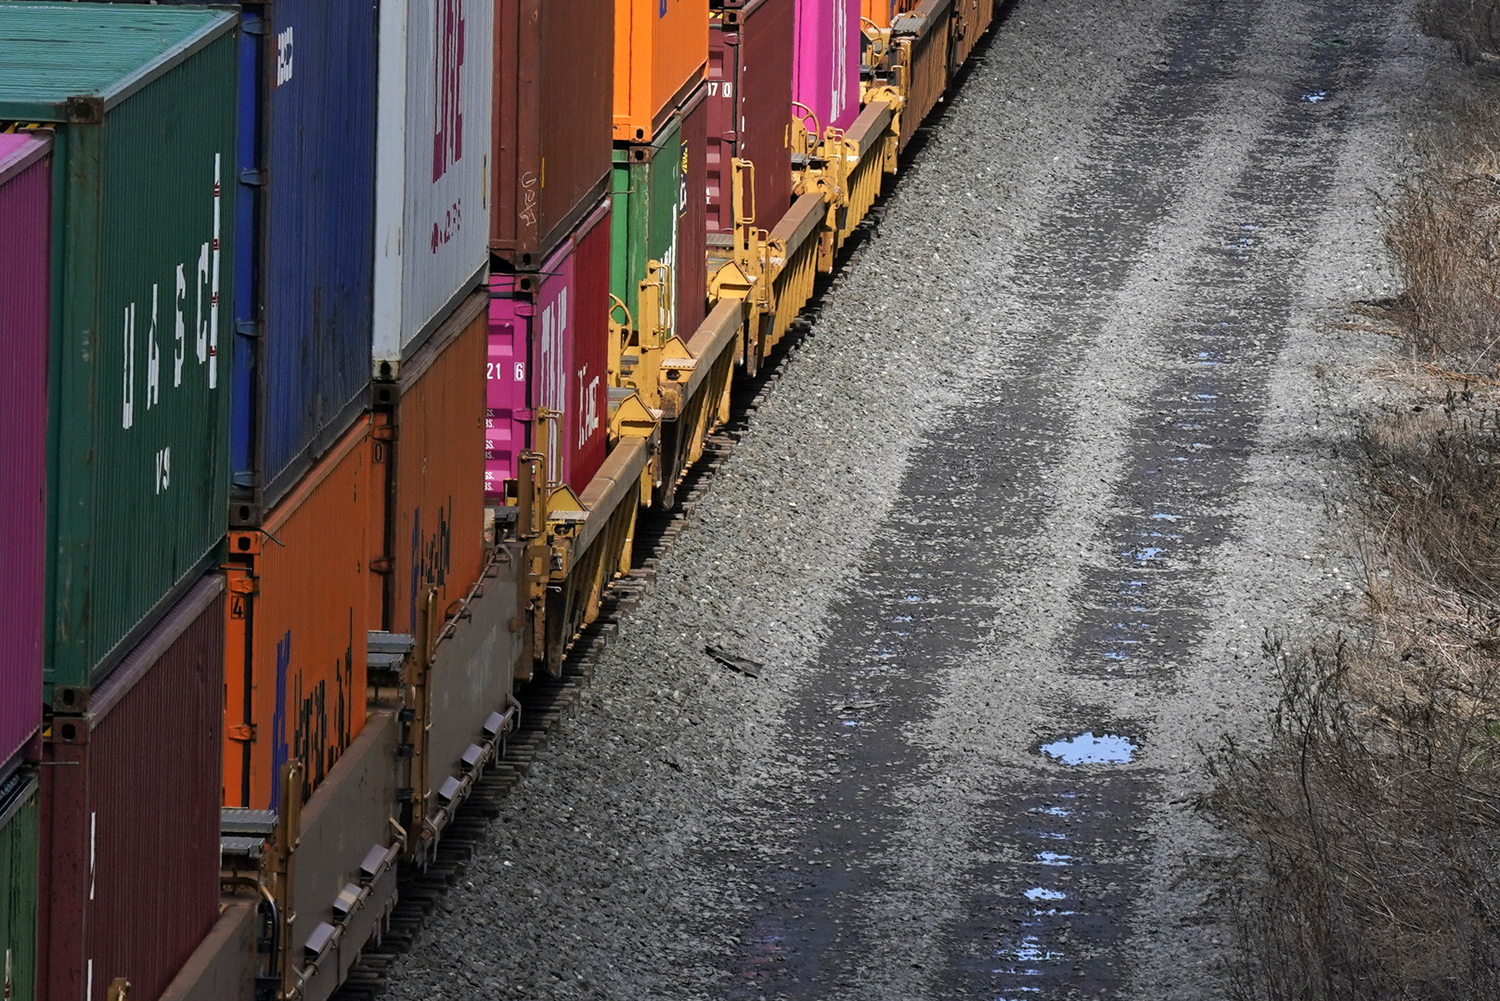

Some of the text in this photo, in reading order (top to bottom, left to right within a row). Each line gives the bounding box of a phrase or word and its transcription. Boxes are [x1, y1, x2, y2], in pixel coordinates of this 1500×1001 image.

[723, 83, 731, 97] 0
[123, 242, 209, 430] UASC
[515, 362, 524, 380] 6
[374, 444, 383, 462] 0
[232, 597, 243, 618] 4
